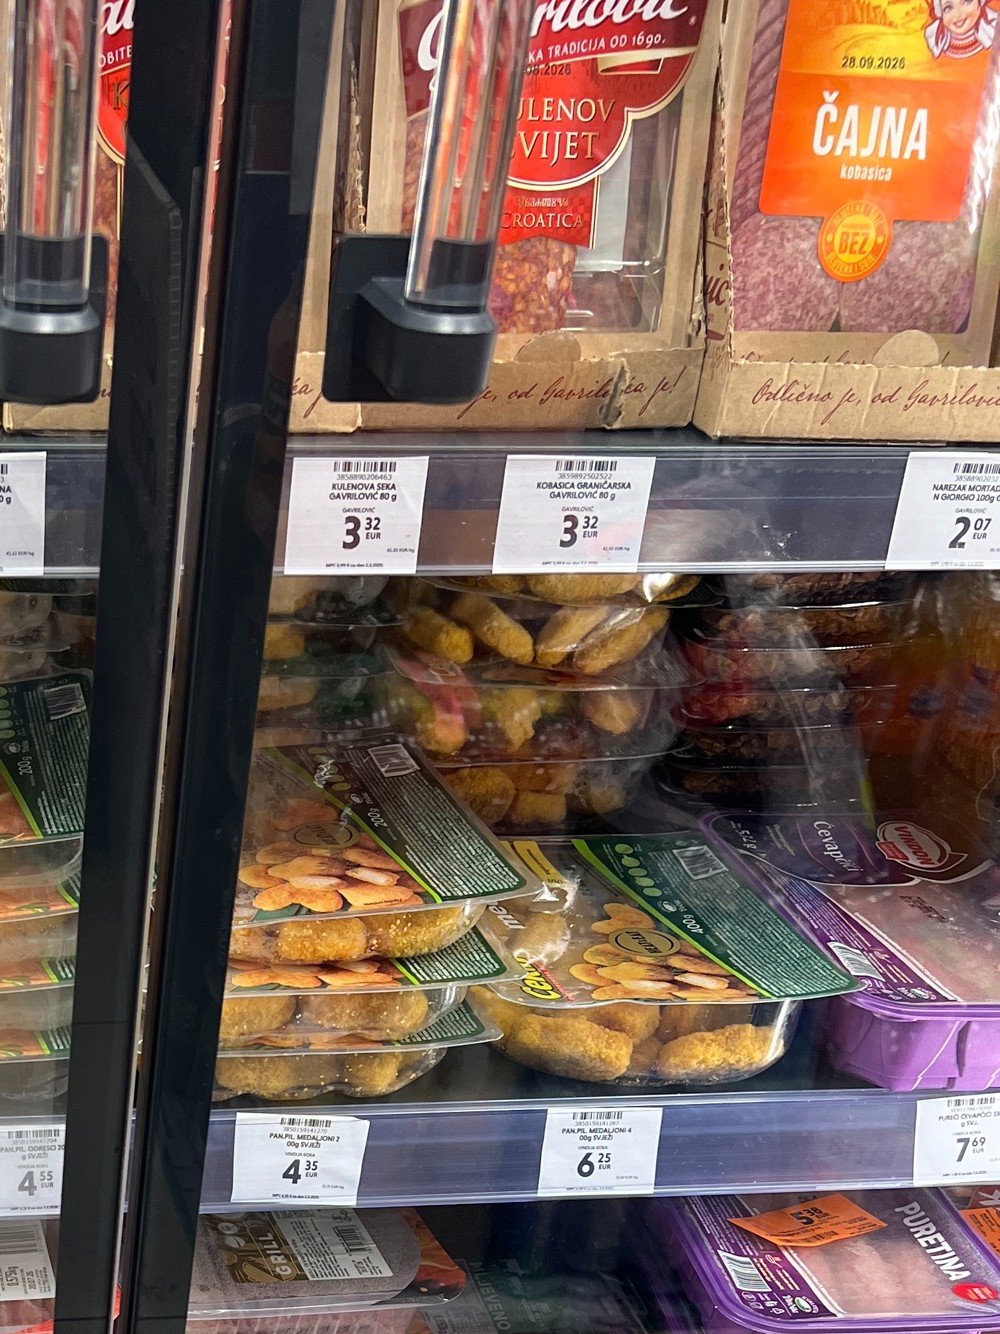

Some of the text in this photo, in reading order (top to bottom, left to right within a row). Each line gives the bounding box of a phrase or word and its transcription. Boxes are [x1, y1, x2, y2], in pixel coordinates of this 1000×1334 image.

[548, 33, 666, 59] TRADICIJA OD 1690.
[841, 56, 905, 69] 28.09.2026
[812, 91, 928, 160] ČAJNA
[515, 131, 600, 167] VIJET
[840, 164, 892, 181] kobasica
[501, 212, 584, 228] CROATICA
[838, 231, 870, 254] BEZ
[329, 492, 378, 500] GAVRILOVIĆ
[537, 481, 631, 490] KOBASICA GRANIČARSKA
[550, 490, 598, 499] GAVRILOVIĆ
[976, 494, 994, 503] 100g
[342, 516, 381, 550] 3 32
[559, 514, 598, 548] 3 32
[948, 516, 992, 548] 2 07
[17, 756, 33, 776] 200g
[895, 824, 936, 867] VINDON
[297, 1134, 335, 1142] MEDALJONI
[956, 1137, 986, 1162] 7 69
[282, 1159, 318, 1184] 4 35
[577, 1152, 611, 1178] 6 25
[18, 1171, 53, 1196] 4 55
[265, 1232, 291, 1276] GRILL
[894, 1201, 972, 1282] PURETINA
